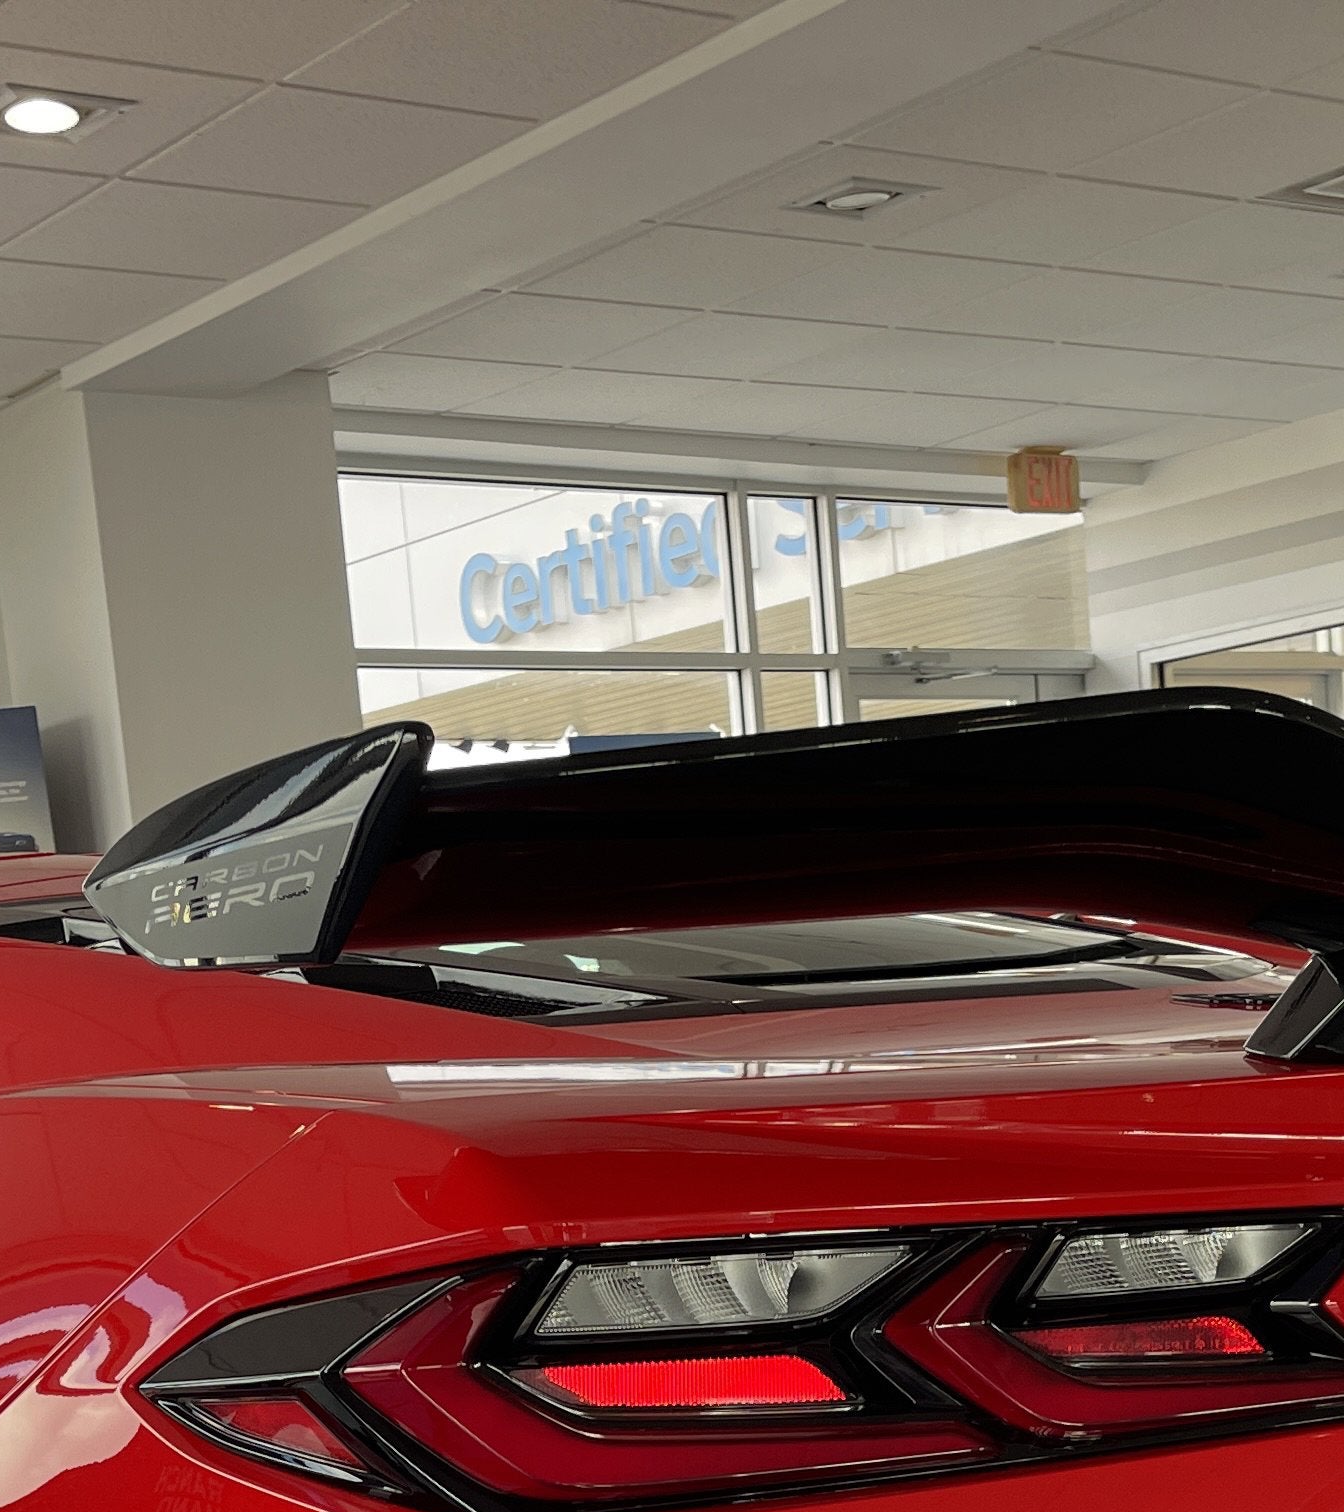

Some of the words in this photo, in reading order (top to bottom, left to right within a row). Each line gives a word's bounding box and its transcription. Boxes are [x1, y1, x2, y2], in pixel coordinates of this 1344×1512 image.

[1026, 454, 1073, 510] EXIT
[144, 871, 316, 935] AERO
[151, 844, 324, 903] CARBON
